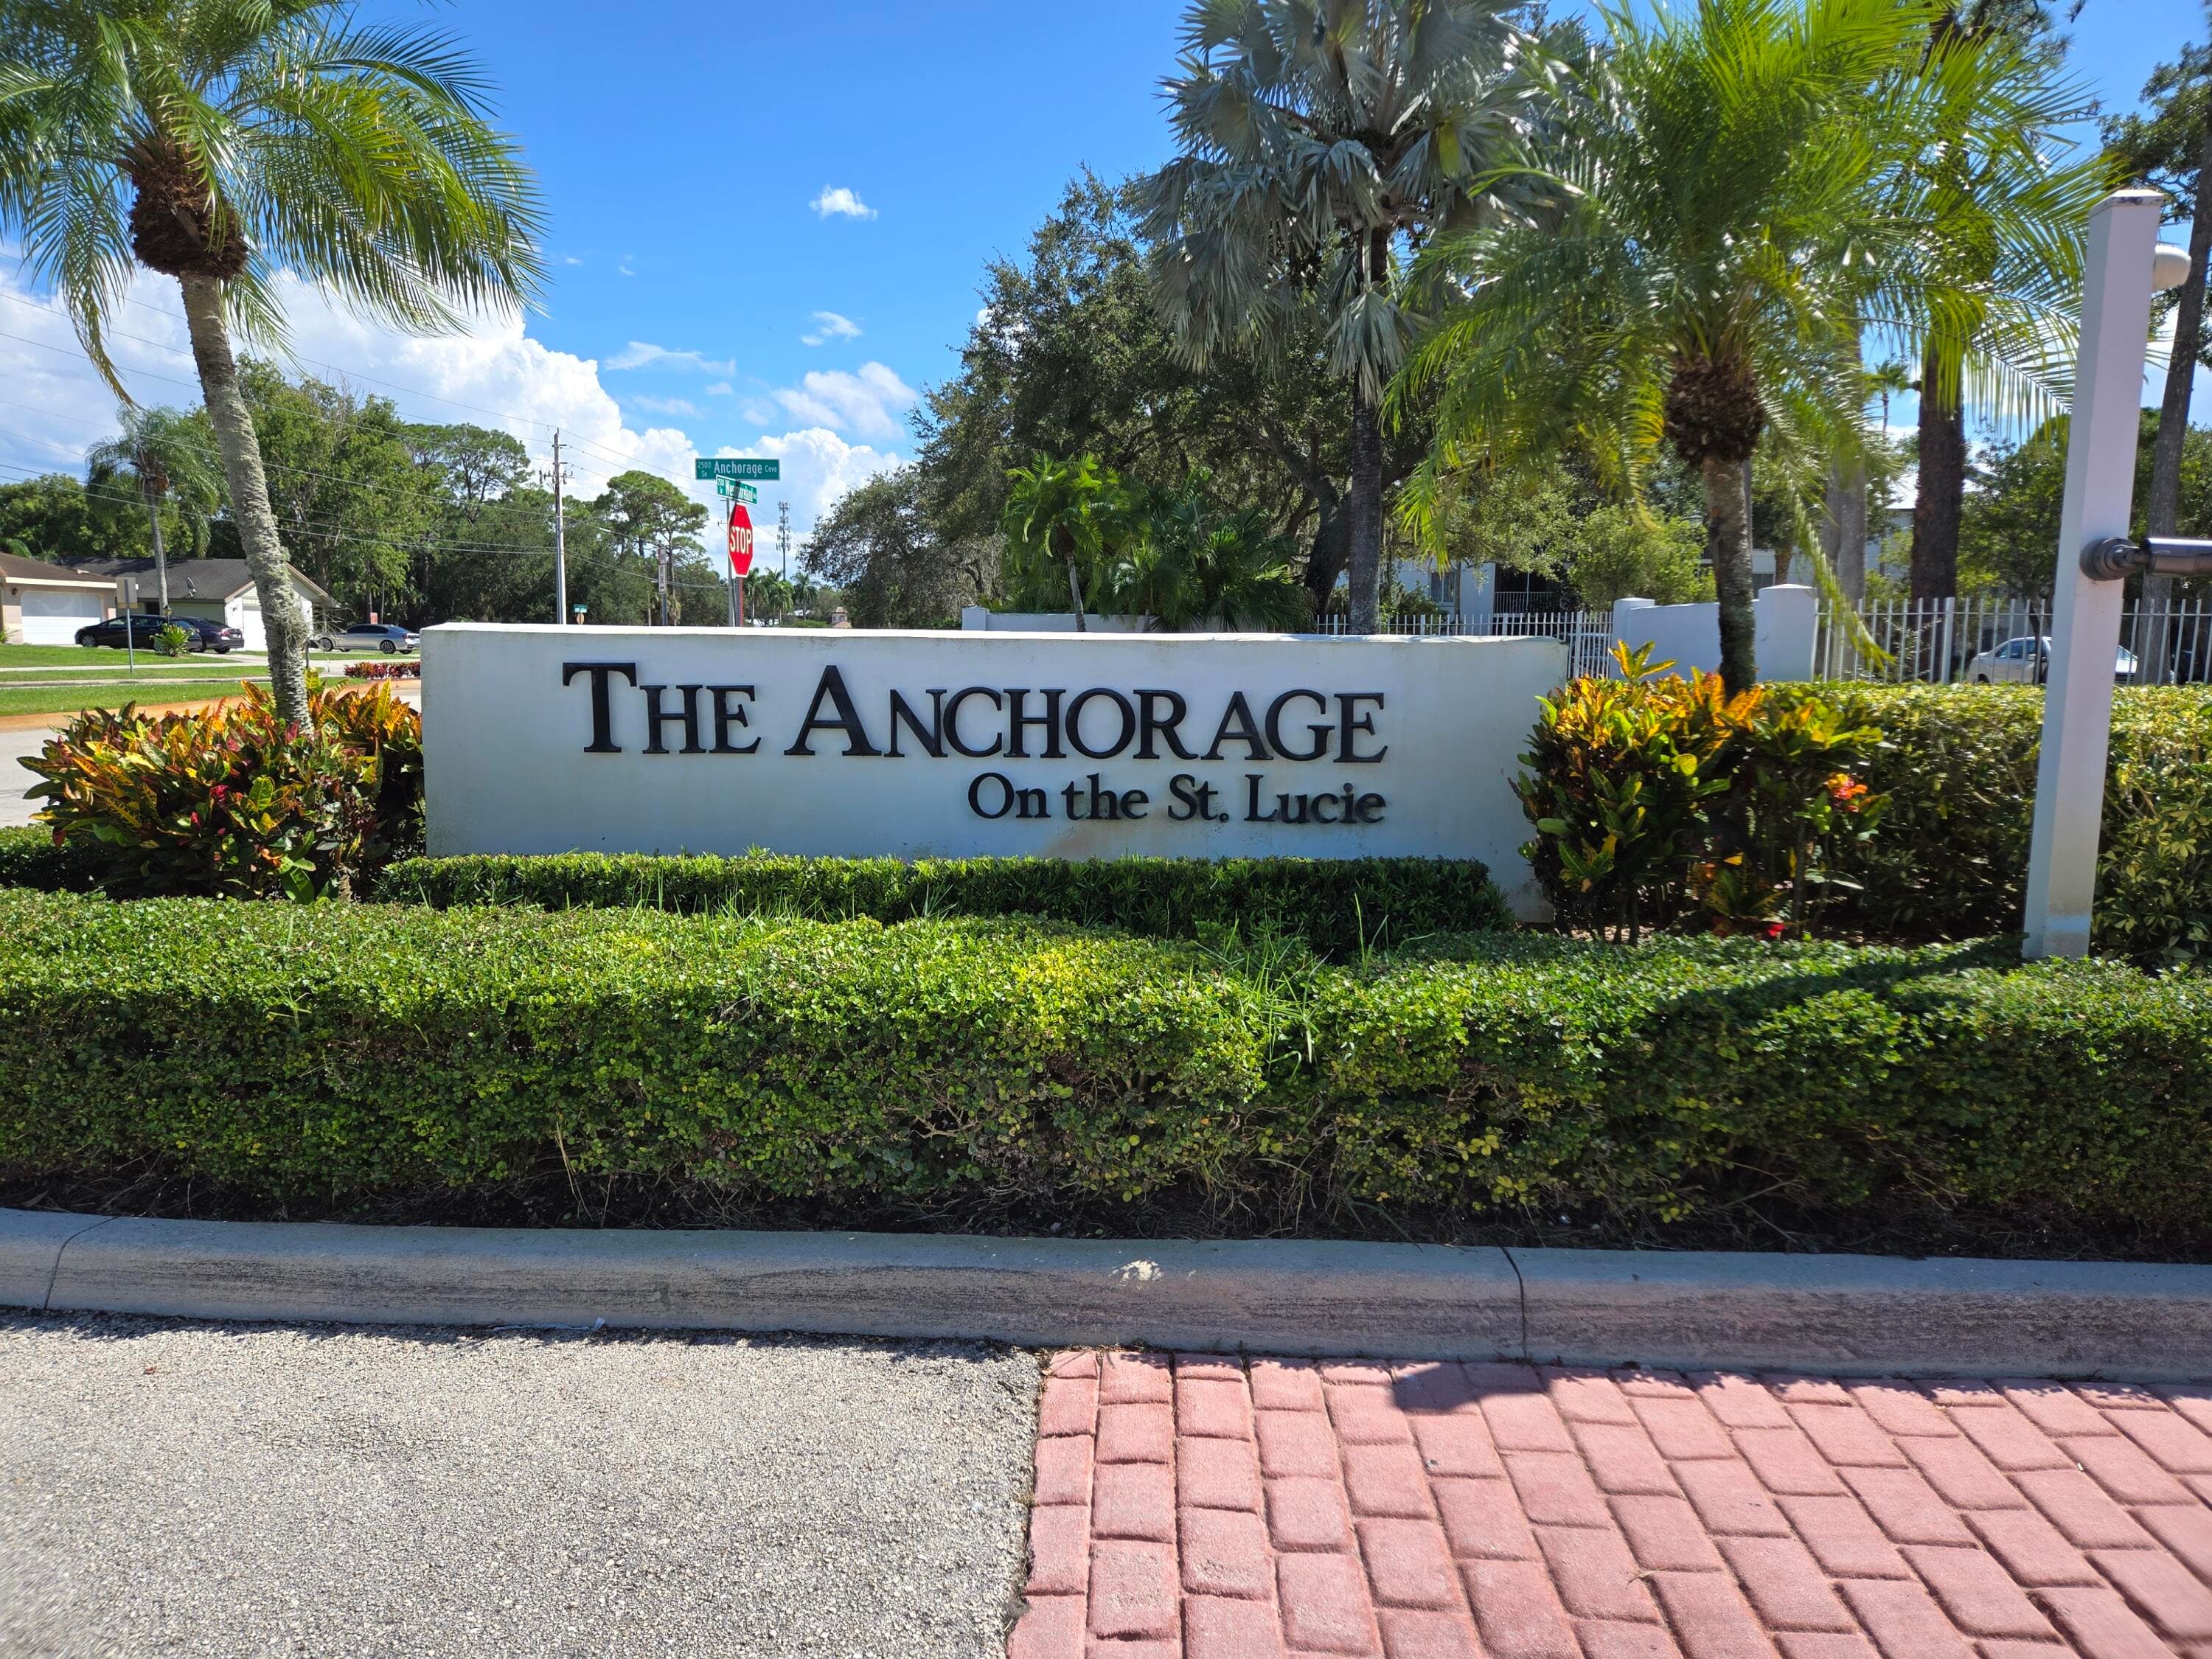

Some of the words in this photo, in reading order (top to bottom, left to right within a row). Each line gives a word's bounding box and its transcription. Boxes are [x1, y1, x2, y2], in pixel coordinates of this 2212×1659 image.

[698, 461, 712, 469] 2500
[714, 460, 762, 478] Anchorage
[765, 465, 777, 473] Cove
[725, 479, 753, 502] Wesoreland
[730, 525, 752, 554] STOP
[563, 662, 762, 754] THE
[784, 665, 1388, 763] ANCHORAGE
[968, 772, 1051, 819] On
[1061, 773, 1149, 821] the
[1168, 773, 1229, 823] St.
[1244, 774, 1387, 824] Lucie
